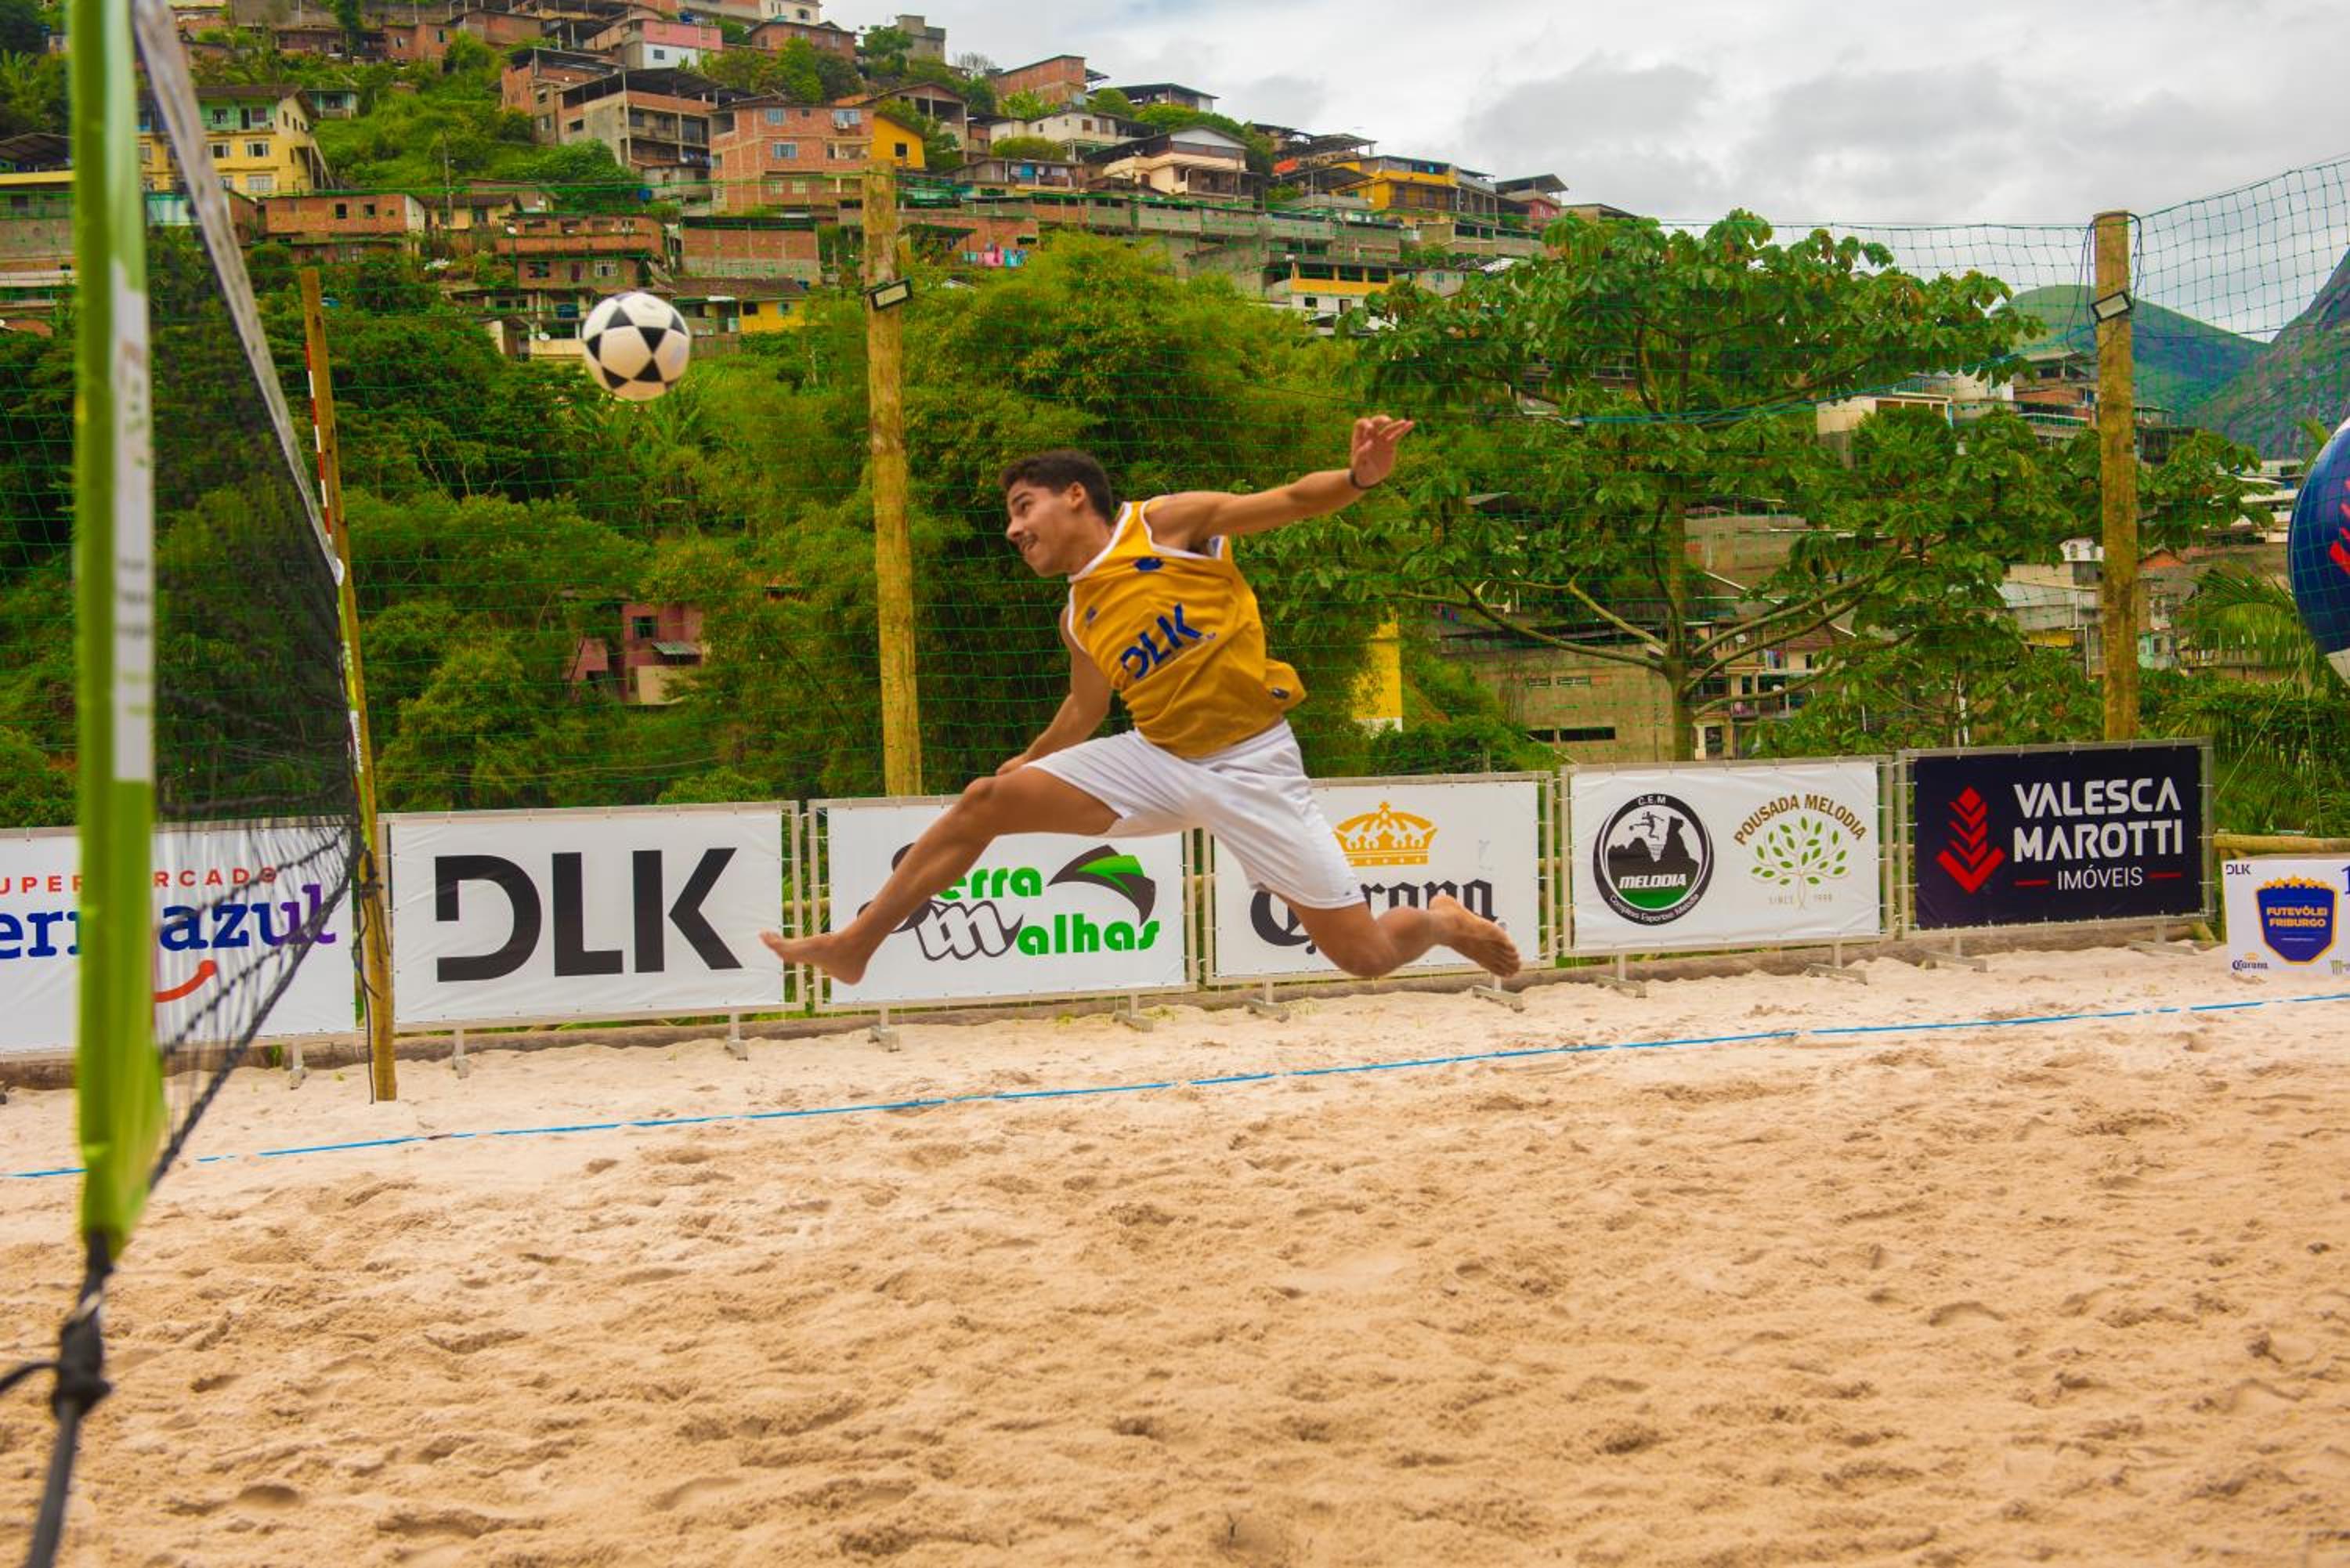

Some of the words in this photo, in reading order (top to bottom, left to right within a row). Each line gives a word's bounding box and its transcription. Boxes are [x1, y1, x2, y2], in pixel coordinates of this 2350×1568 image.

[1120, 602, 1202, 679] DLK
[2013, 777, 2182, 818] VALESCA
[1734, 794, 1800, 846] POUSADA
[1805, 793, 1867, 840] MELODIA
[2013, 819, 2182, 862] MAROTTI
[1619, 873, 1686, 889] MELODIA
[2058, 865, 2143, 891] IMÓVEIS
[2225, 864, 2251, 875] DLK
[435, 847, 743, 983] DLK
[2269, 918, 2326, 927] FRIBURGO
